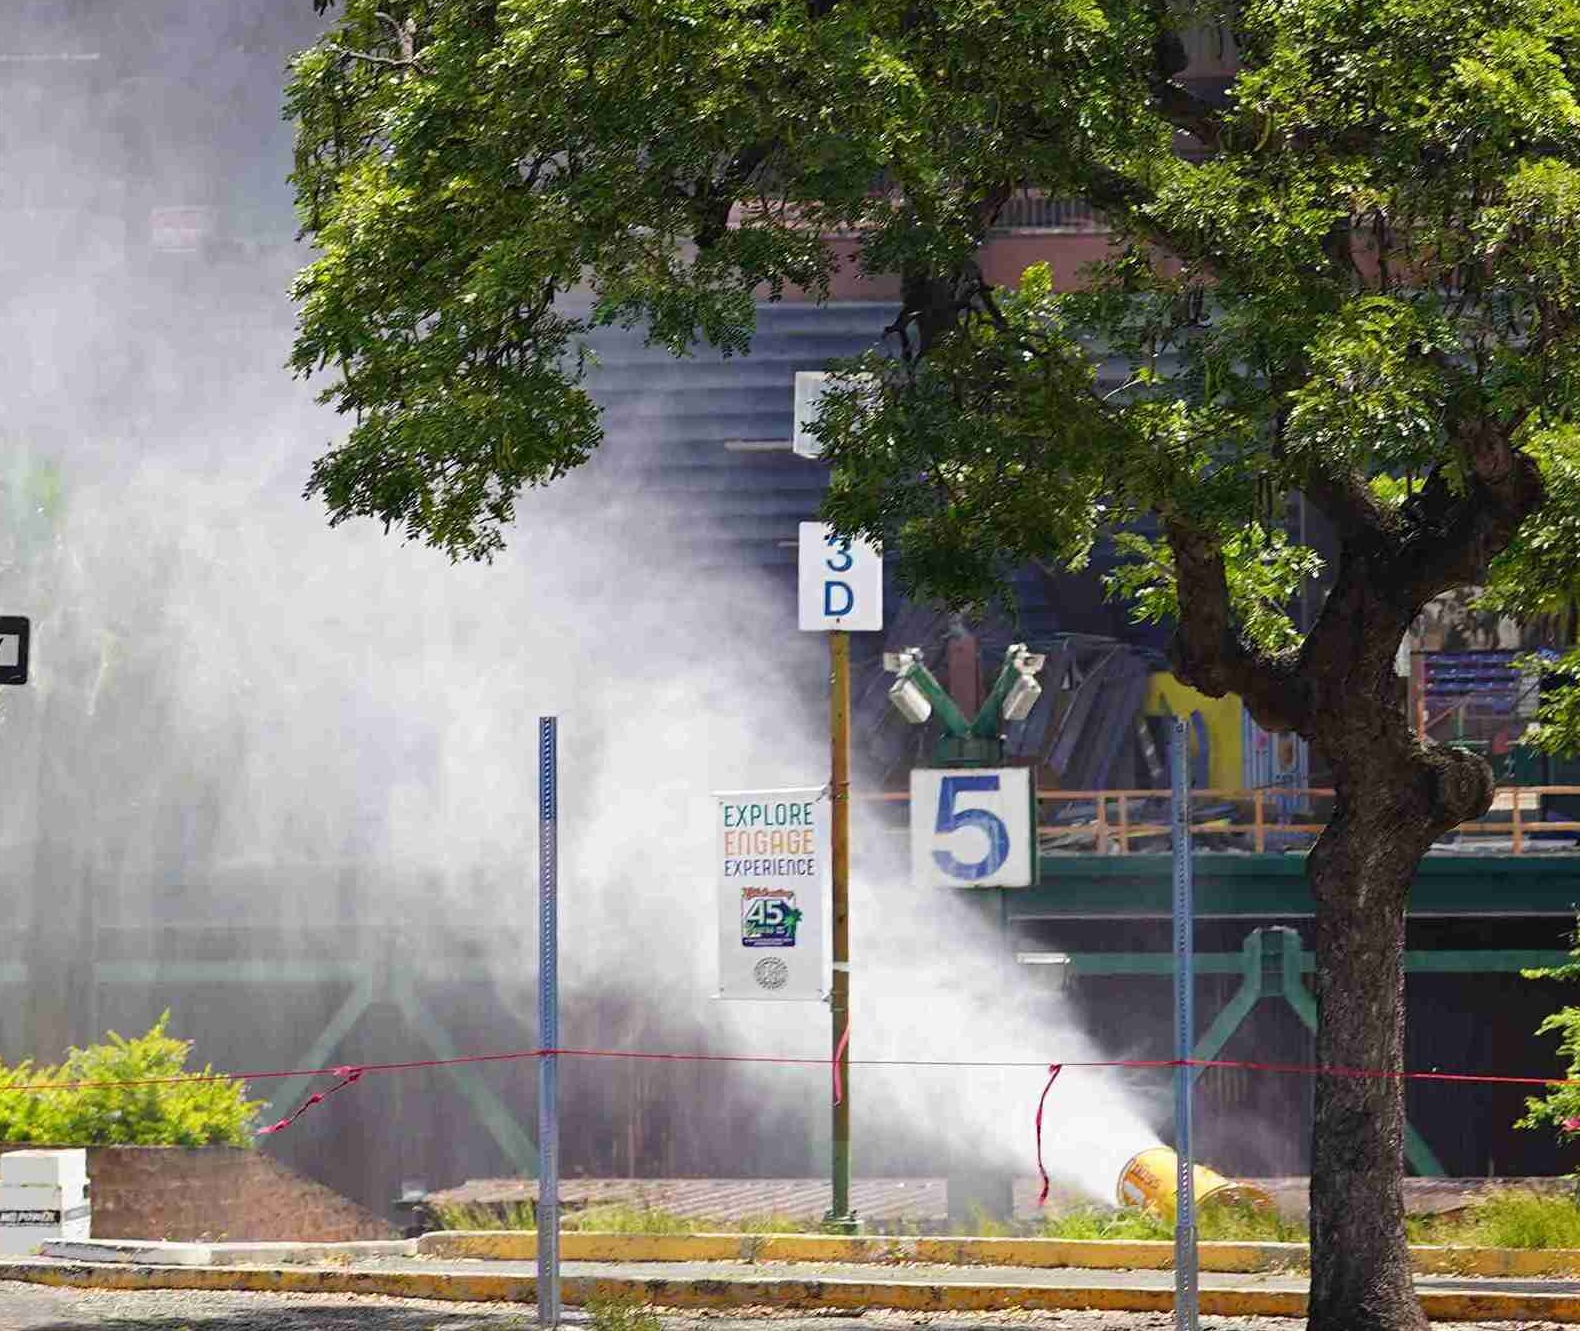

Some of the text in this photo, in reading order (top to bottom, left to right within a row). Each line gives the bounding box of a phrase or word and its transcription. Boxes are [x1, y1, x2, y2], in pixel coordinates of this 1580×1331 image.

[826, 535, 852, 572] 3
[824, 581, 853, 616] D
[724, 803, 813, 827] EXPLORE
[932, 775, 1010, 881] 5
[724, 830, 814, 856] ENGAGE
[724, 859, 815, 877] EXPERIENCE
[745, 899, 784, 925] 45
